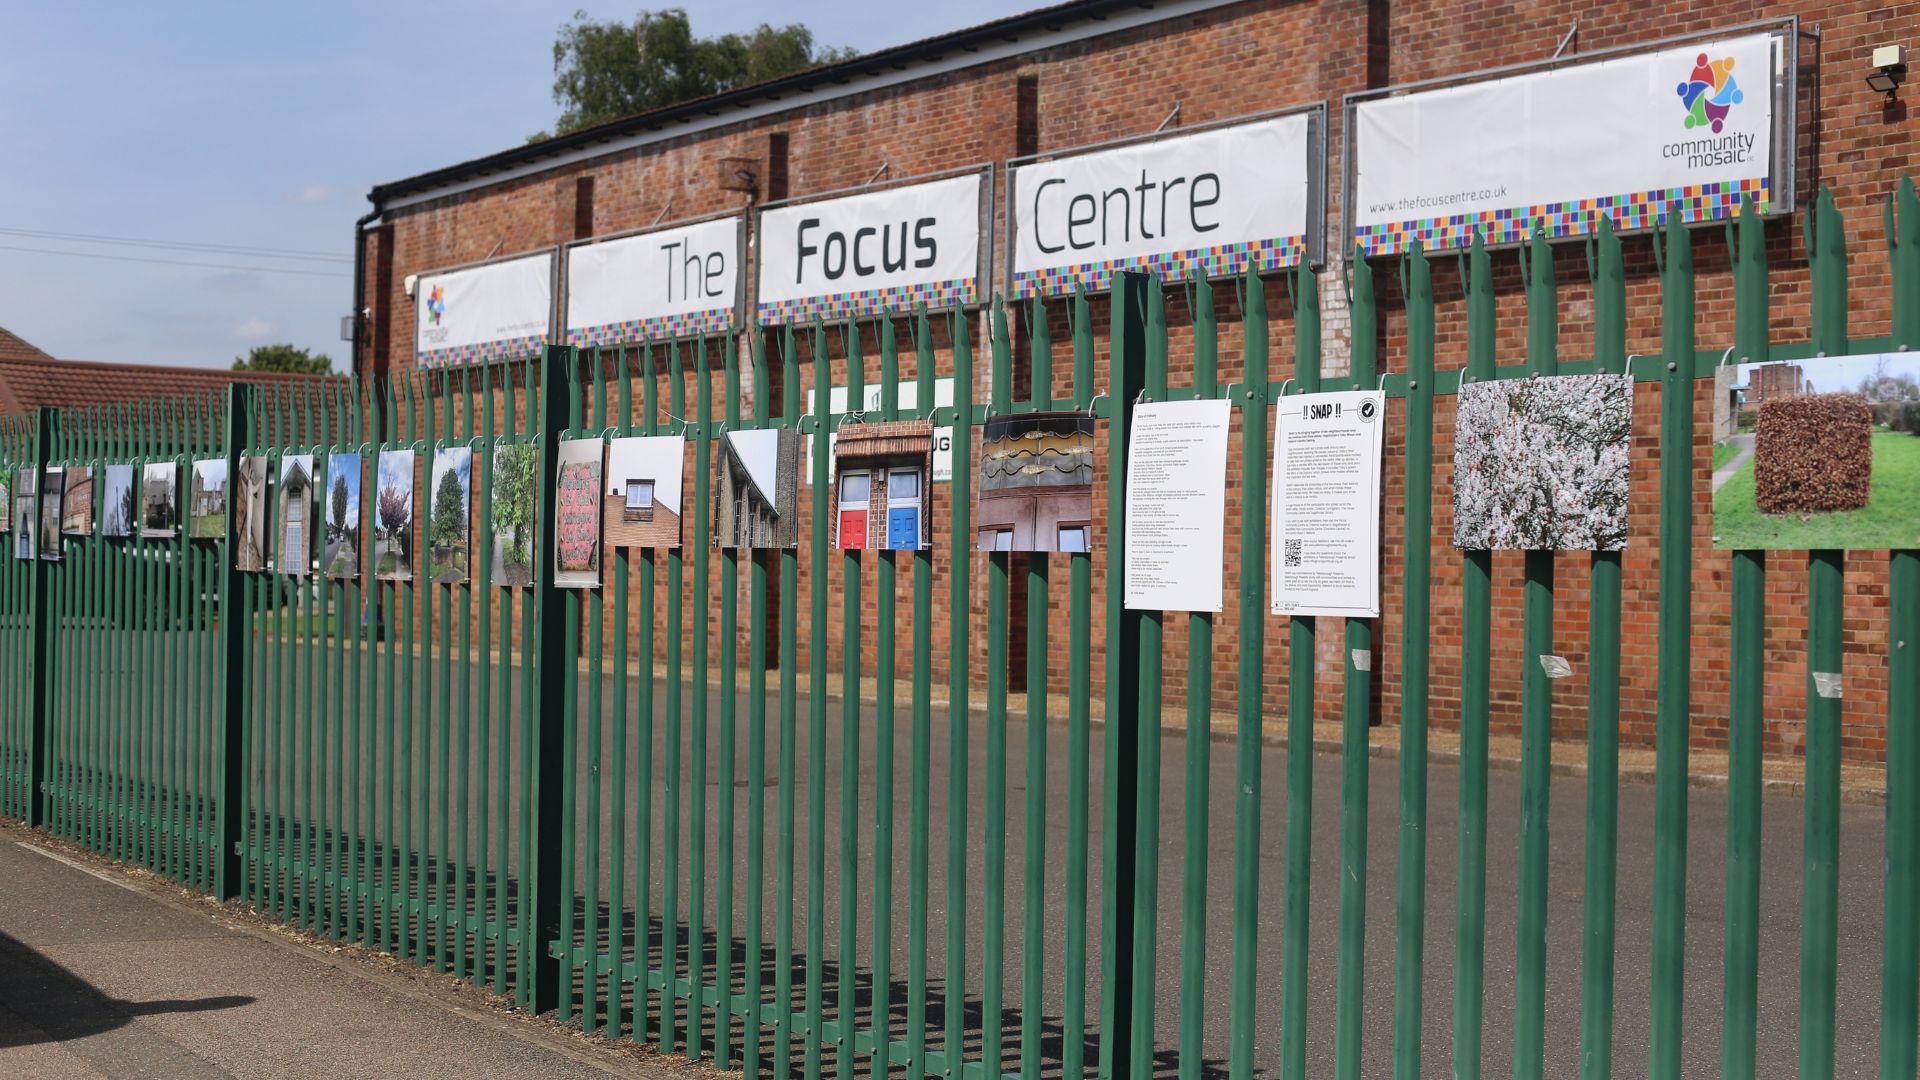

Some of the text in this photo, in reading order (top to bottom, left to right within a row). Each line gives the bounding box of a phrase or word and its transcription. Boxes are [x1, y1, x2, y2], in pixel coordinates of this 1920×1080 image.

[1662, 132, 1755, 158] community
[1688, 149, 1746, 168] mosaic
[1033, 168, 1221, 255] Centre
[1369, 184, 1507, 213] www.thefocuscentre.co.uk
[796, 216, 938, 285] Focus
[660, 236, 725, 303] The
[1310, 403, 1333, 420] SNAP
